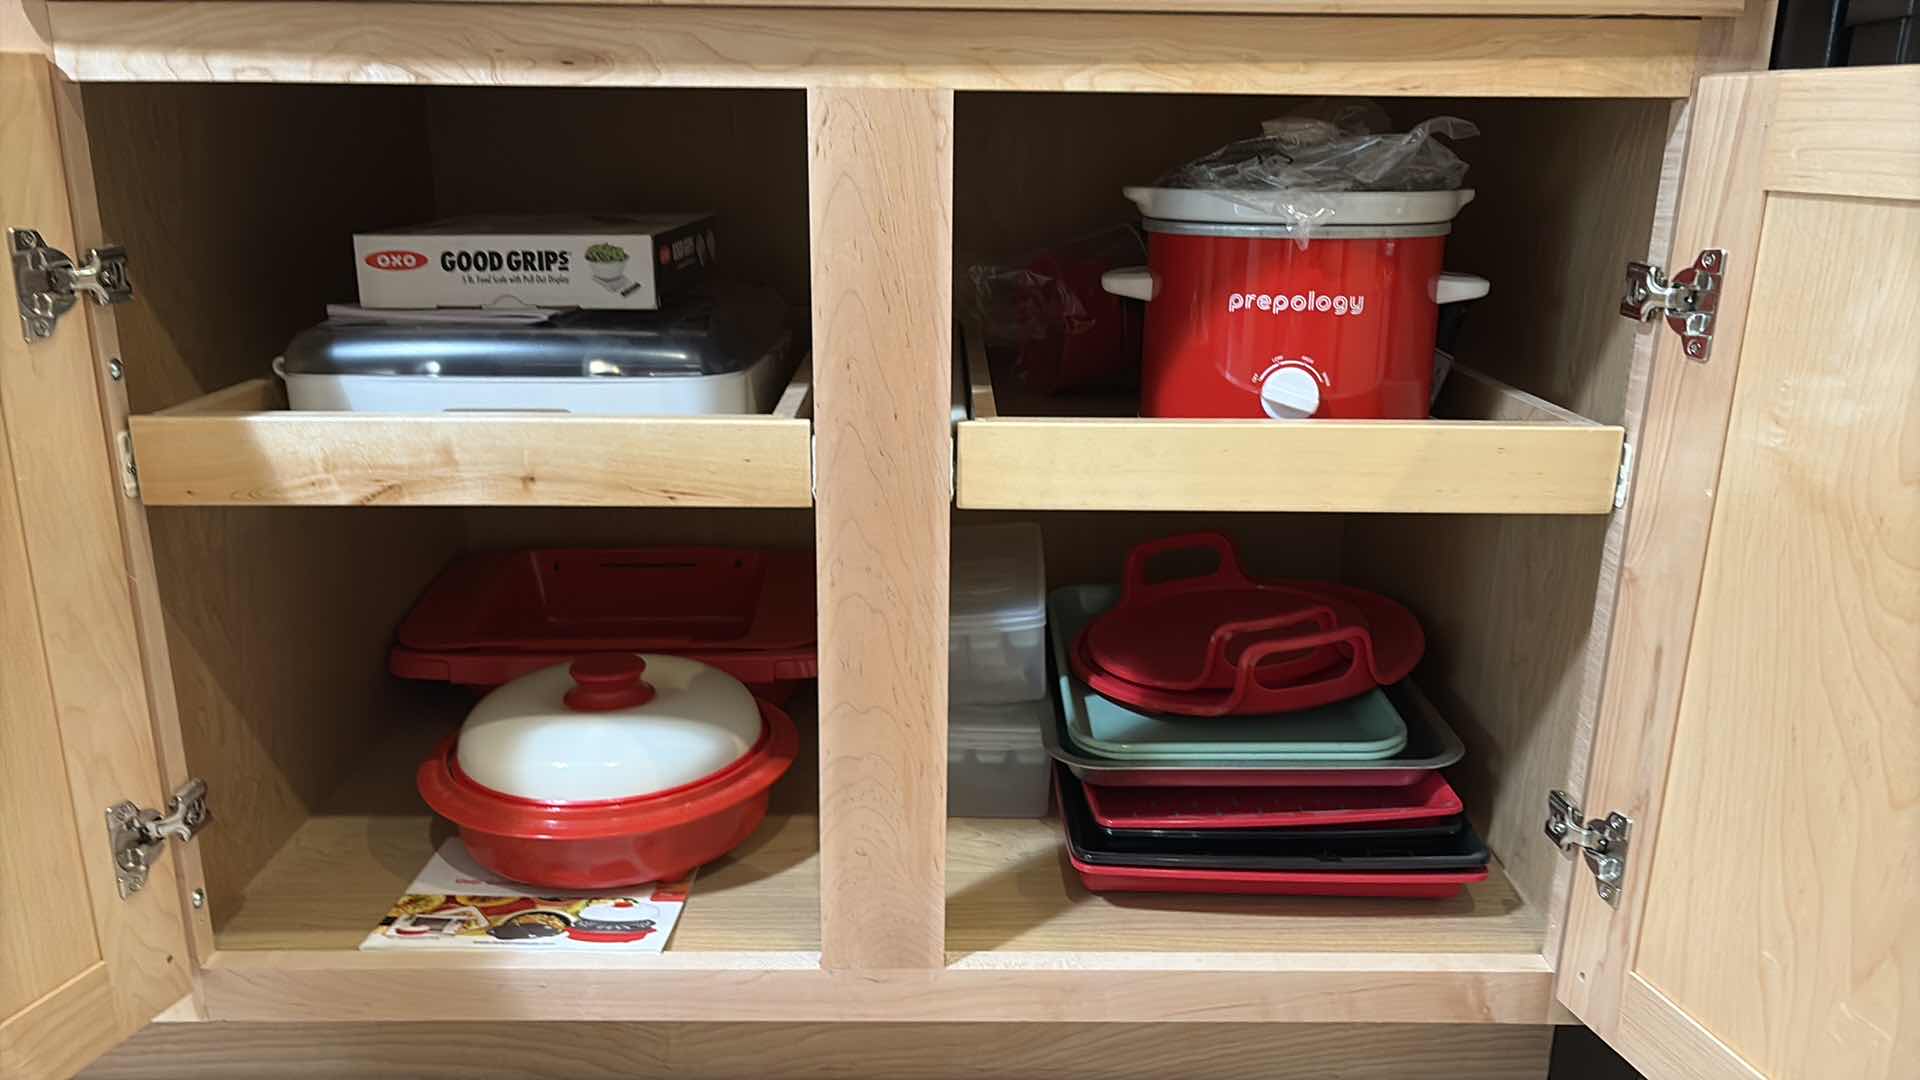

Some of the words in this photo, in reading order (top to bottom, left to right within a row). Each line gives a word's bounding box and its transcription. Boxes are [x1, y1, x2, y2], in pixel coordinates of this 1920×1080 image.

[377, 254, 417, 268] OXO
[440, 251, 503, 272] GOOD
[506, 250, 569, 272] GRIPS
[1228, 290, 1364, 316] prepology
